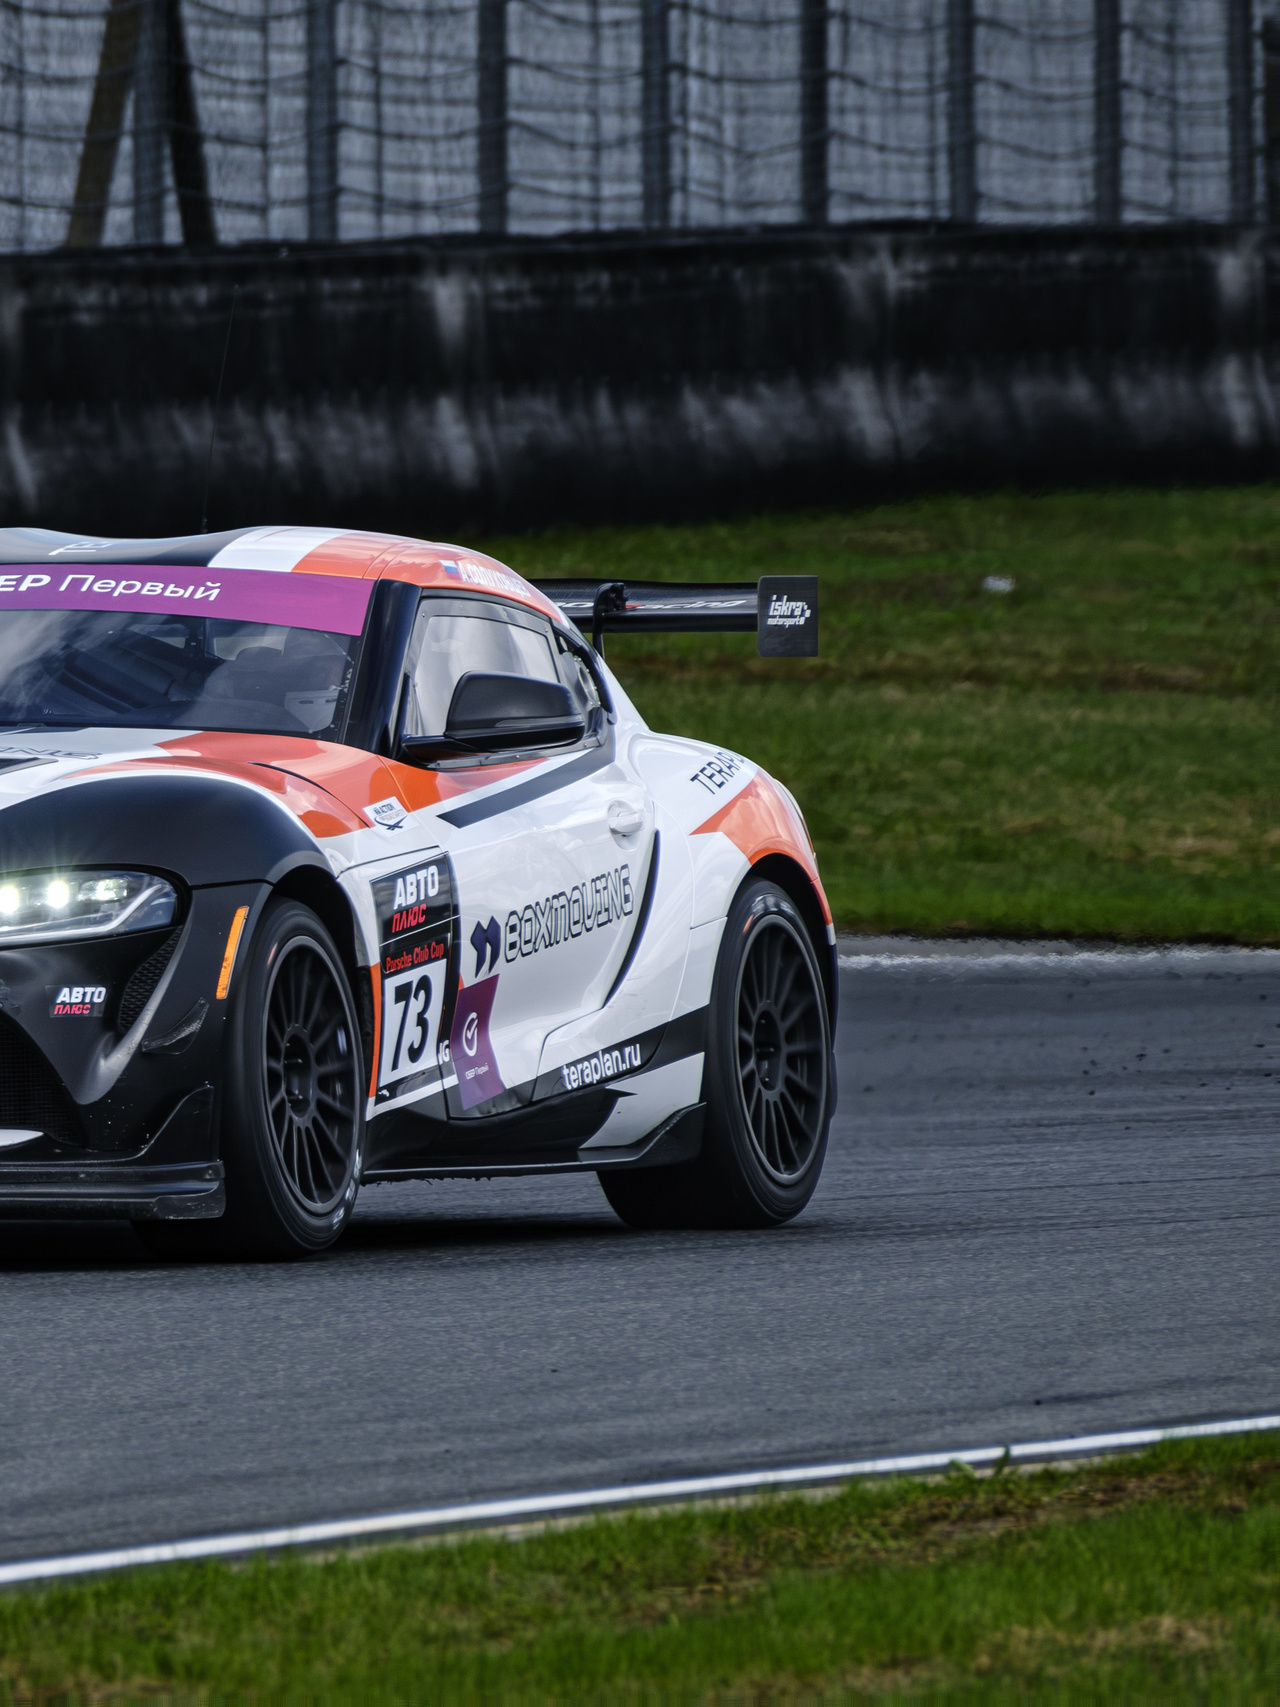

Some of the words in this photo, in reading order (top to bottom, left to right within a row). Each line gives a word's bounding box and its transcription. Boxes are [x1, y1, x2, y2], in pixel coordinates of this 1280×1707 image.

[57, 574, 221, 602] Первый
[769, 595, 803, 616] iskra
[393, 864, 440, 911] АВТО
[392, 903, 427, 934] ПЛЮС
[504, 863, 634, 963] BOXMOVING
[385, 950, 412, 973] Porsche
[413, 944, 429, 965] Club
[430, 941, 444, 959] Cup
[54, 1004, 91, 1015] ПЛЮС
[56, 986, 107, 1004] АВТО
[391, 974, 432, 1073] 73
[563, 1043, 642, 1090] teraplan.ru
